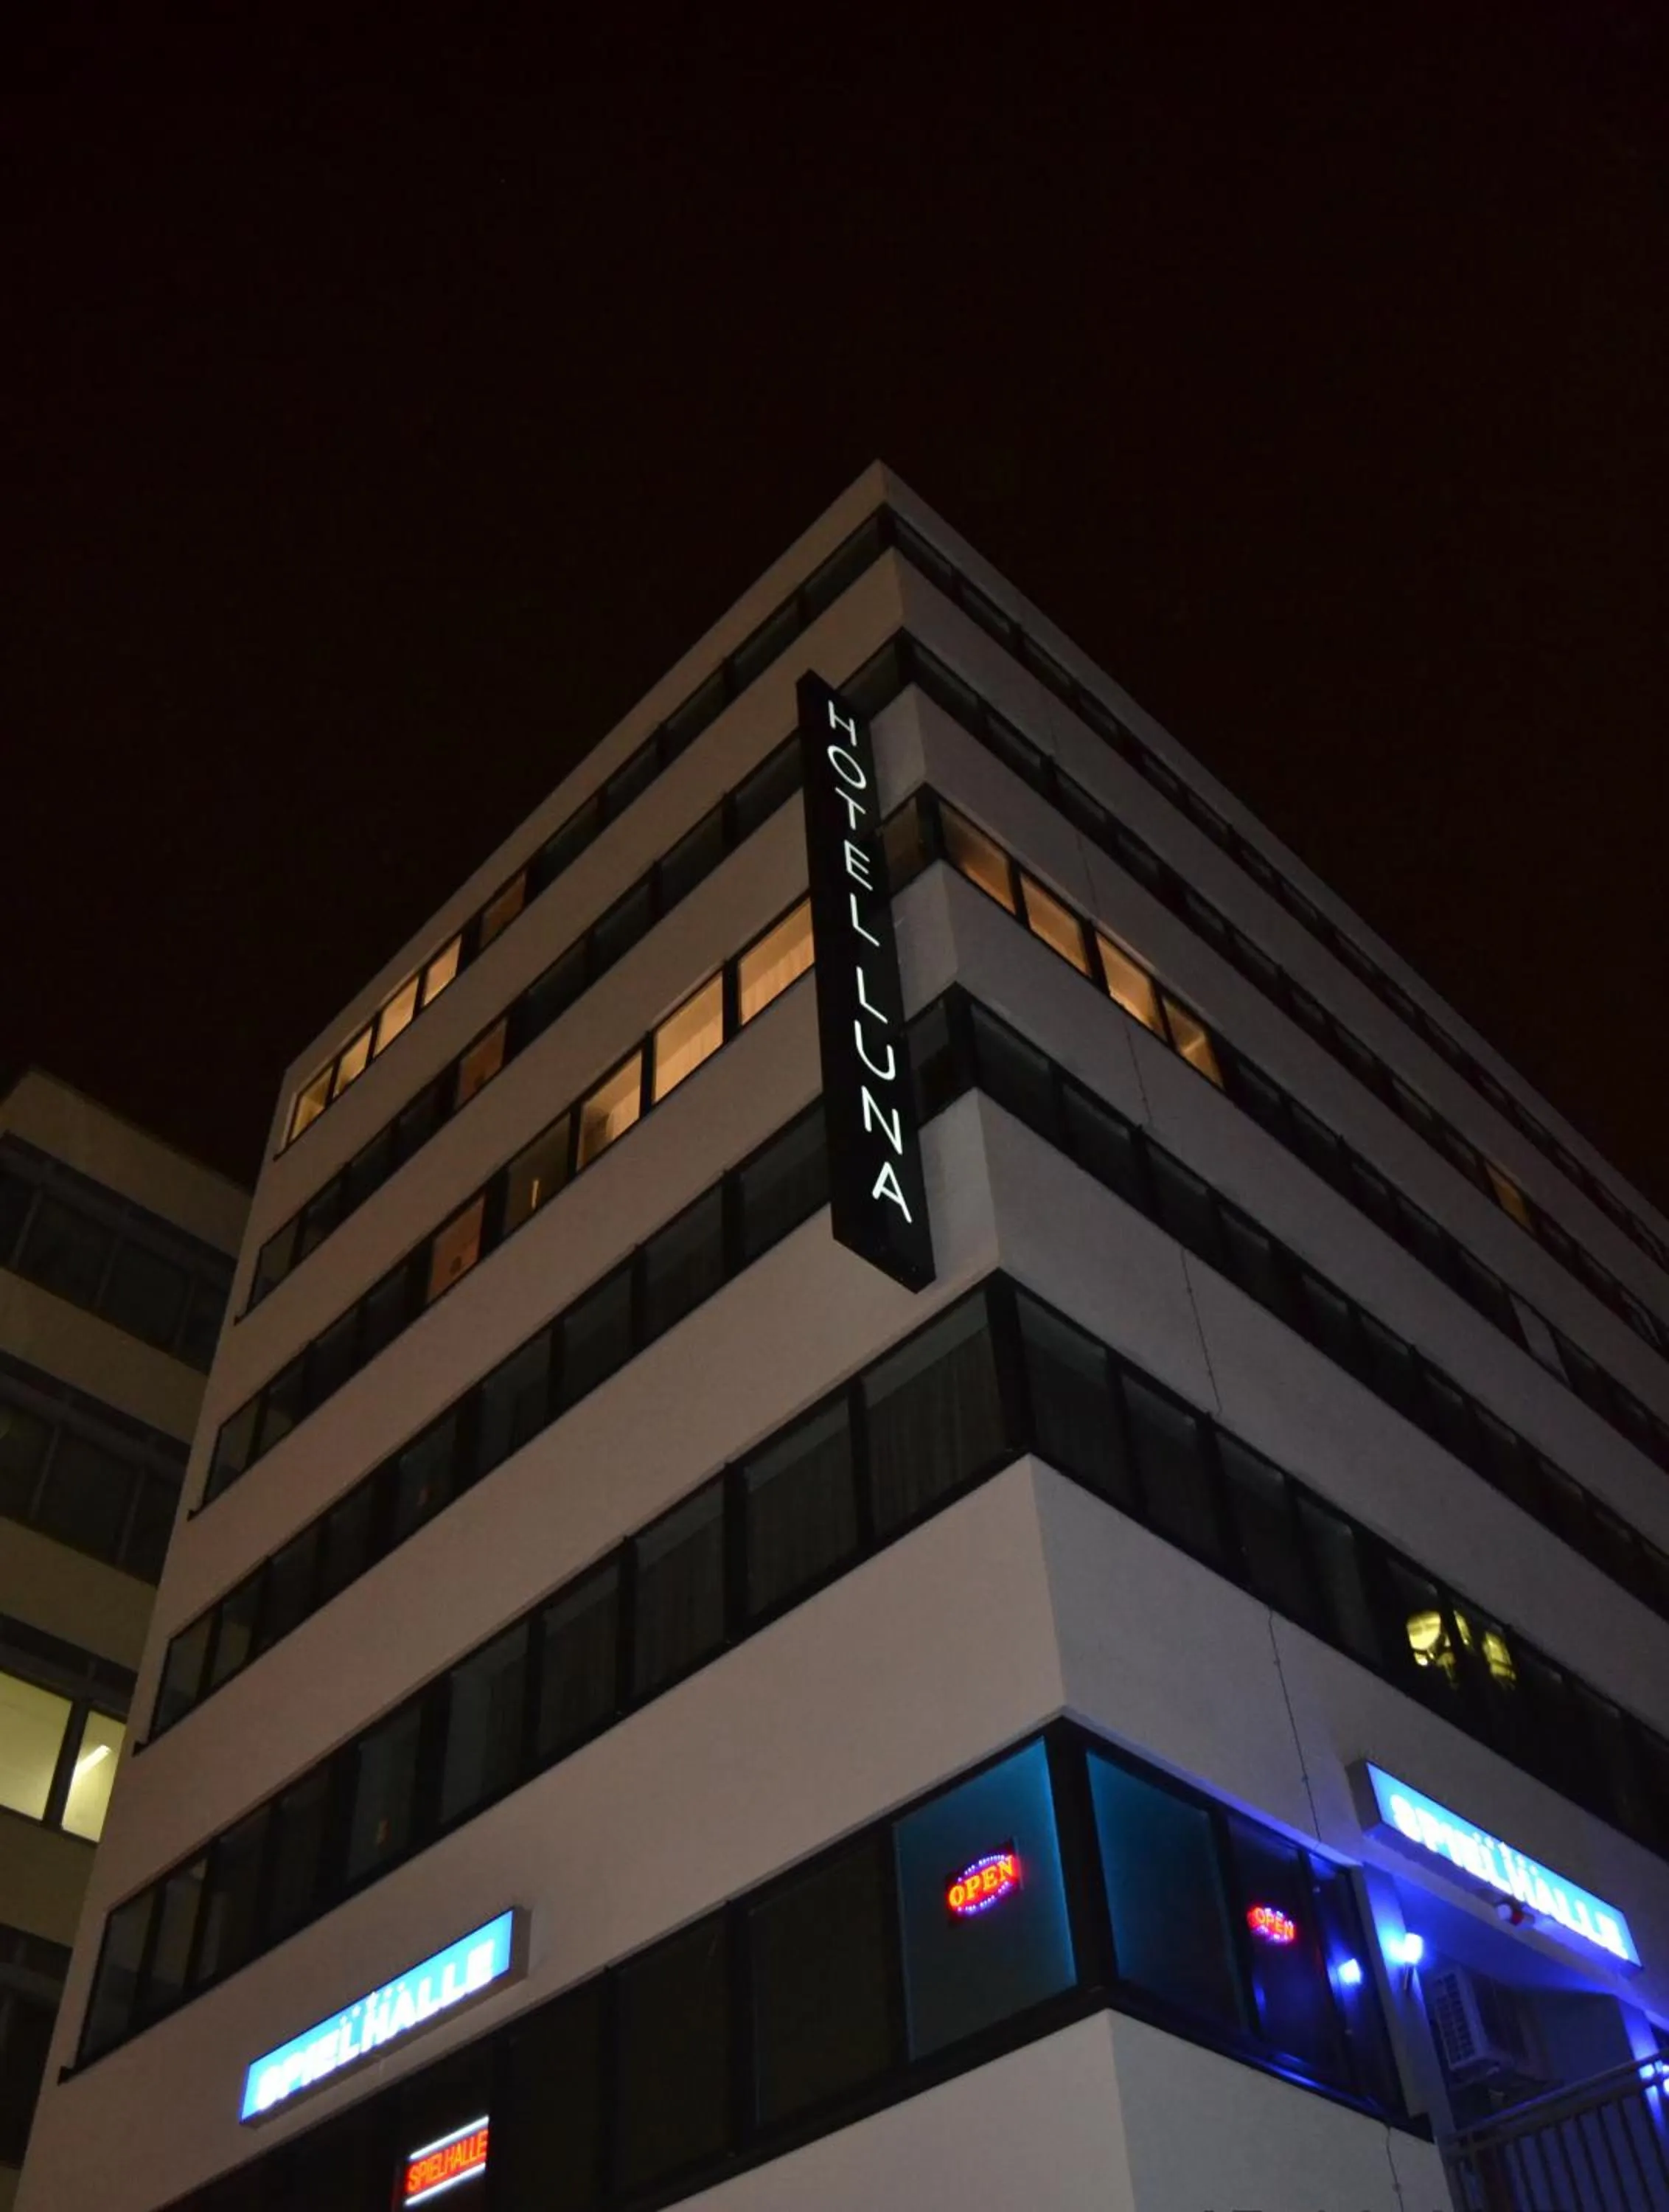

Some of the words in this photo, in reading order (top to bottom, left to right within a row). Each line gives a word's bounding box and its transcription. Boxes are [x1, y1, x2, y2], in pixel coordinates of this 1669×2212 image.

[827, 700, 880, 947] HOTEL
[854, 967, 913, 1224] LUNA
[948, 1854, 1014, 1907] OPEN
[1253, 1907, 1295, 1940] OPEN
[407, 2128, 488, 2193] SPIELHALLE
